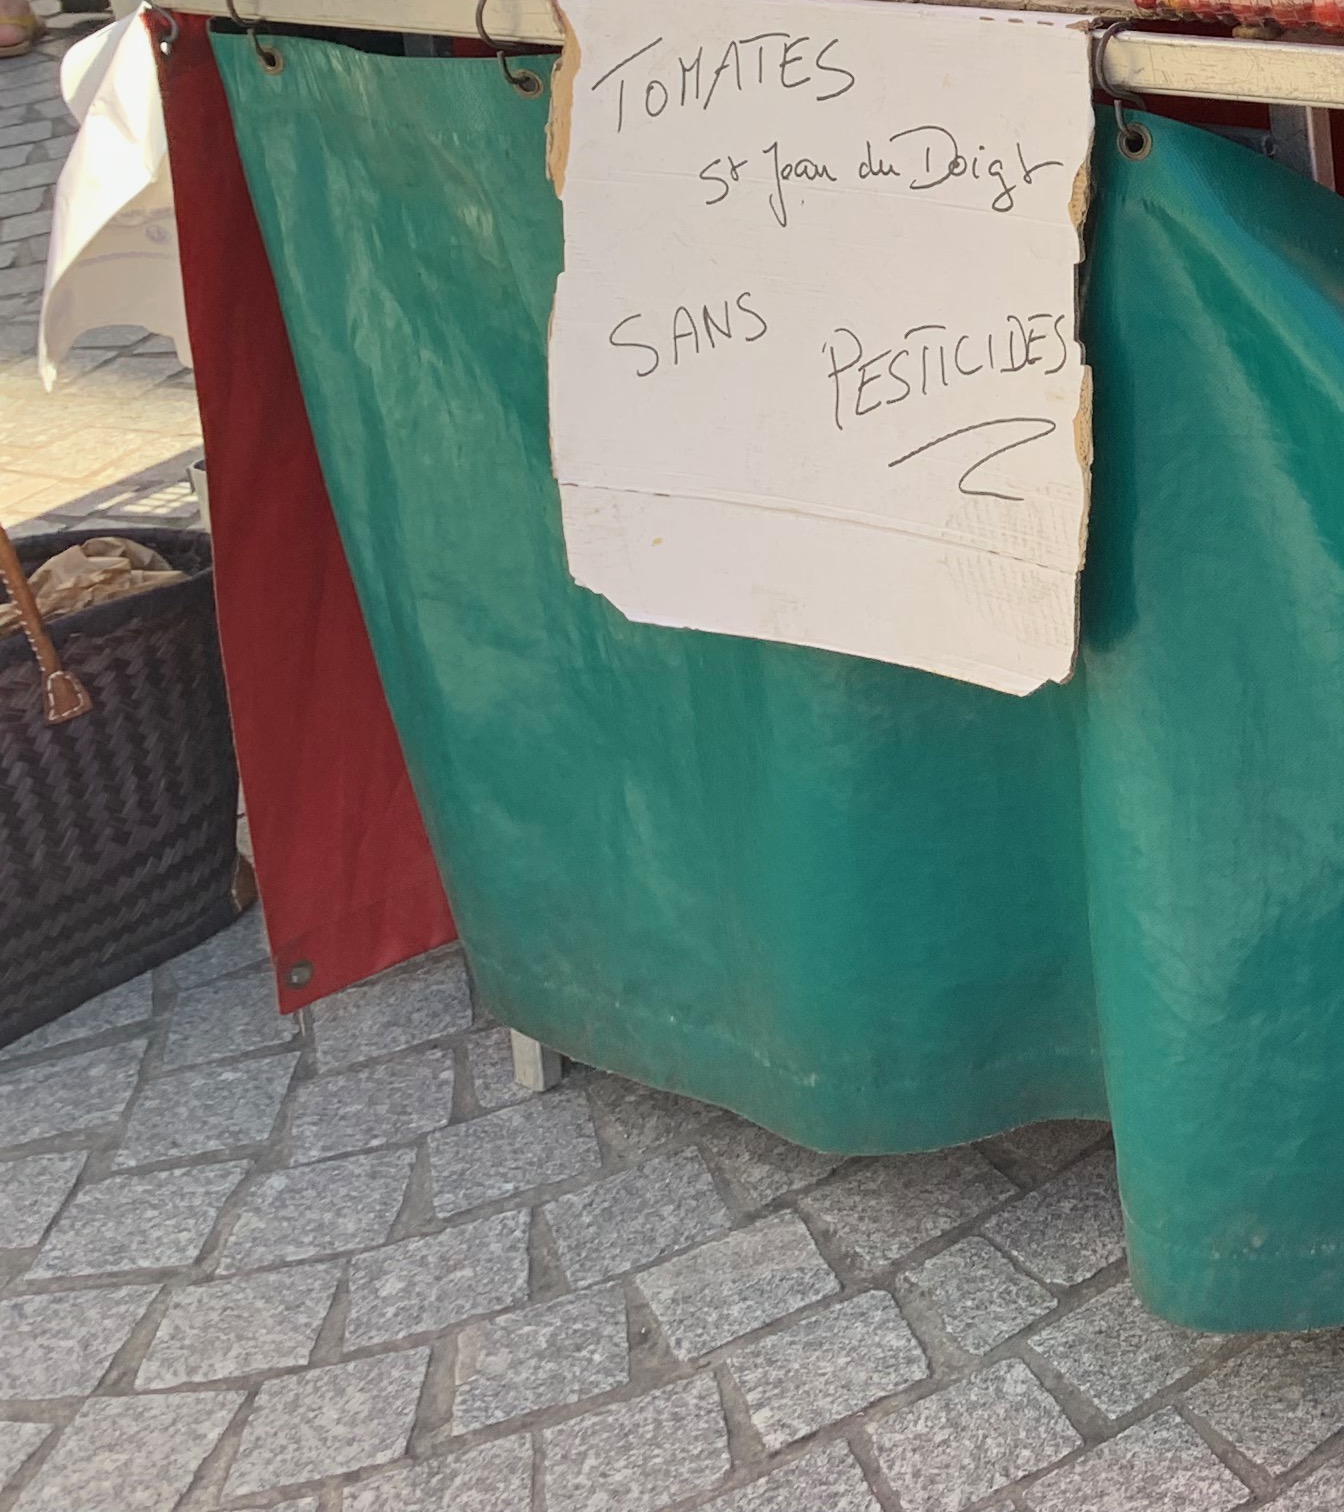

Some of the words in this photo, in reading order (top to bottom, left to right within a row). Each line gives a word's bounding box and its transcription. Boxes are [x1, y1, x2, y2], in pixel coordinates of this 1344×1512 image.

[591, 32, 855, 133] TOMATES
[858, 140, 901, 178] du
[609, 291, 768, 377] SANS
[827, 313, 1067, 431] PESTICIDES
